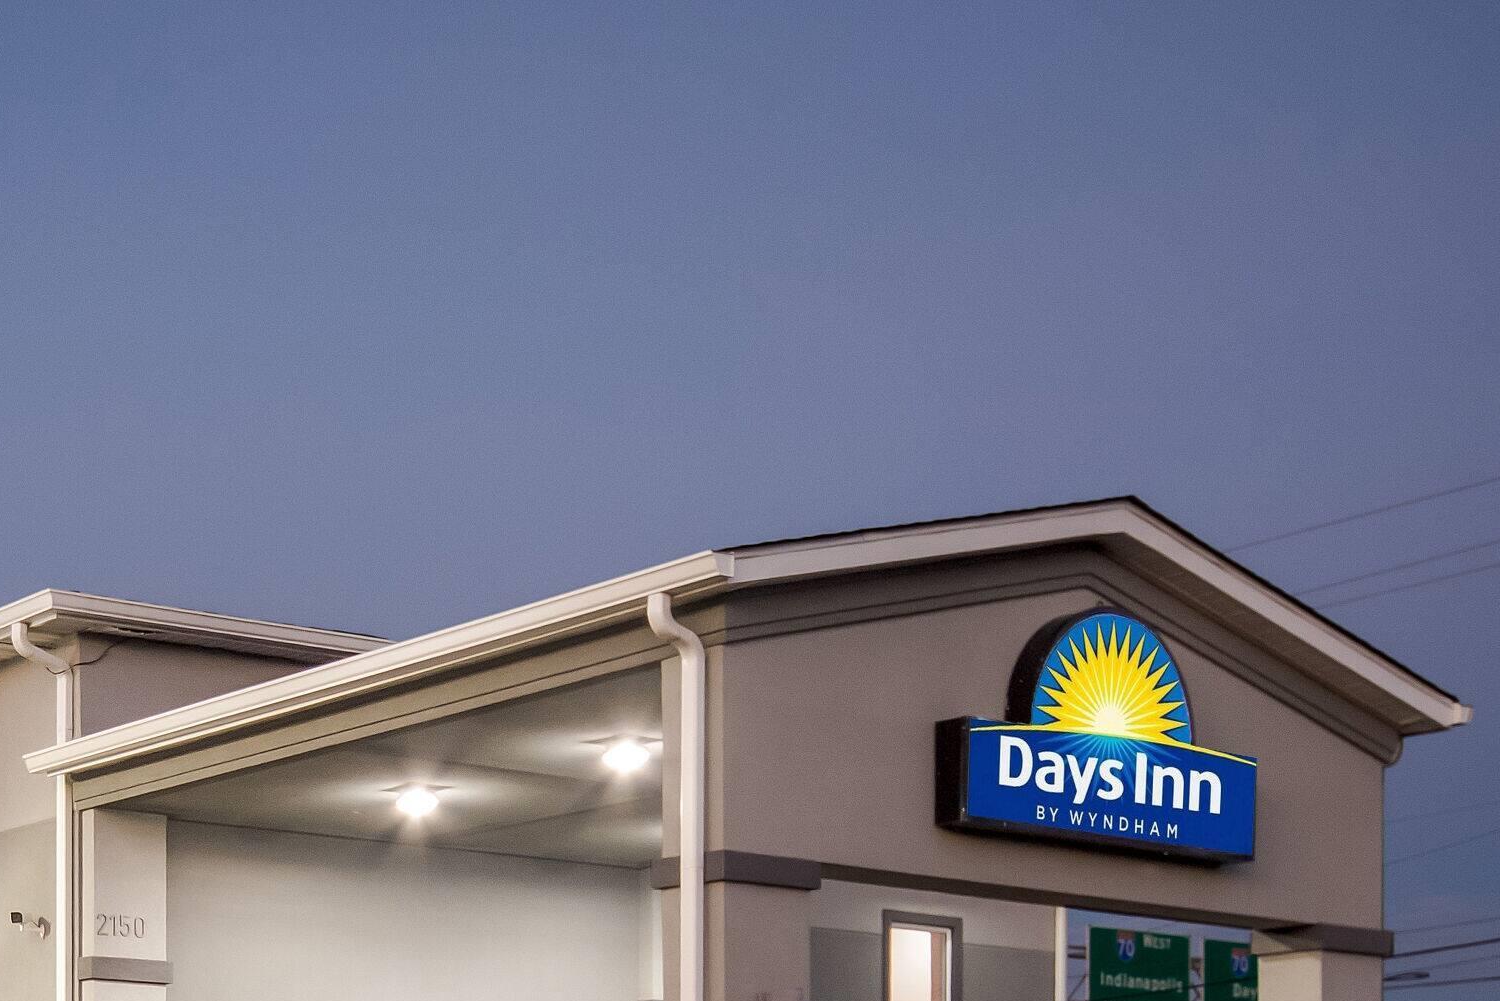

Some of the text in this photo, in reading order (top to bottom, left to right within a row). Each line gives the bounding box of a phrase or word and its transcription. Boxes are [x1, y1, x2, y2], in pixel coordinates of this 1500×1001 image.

[999, 735, 1222, 815] Days Inn
[1036, 805, 1179, 839] BY WYNDHAM
[96, 913, 145, 939] 2150
[1117, 934, 1171, 957] 70 WEST
[1100, 971, 1183, 993] Indianapolis
